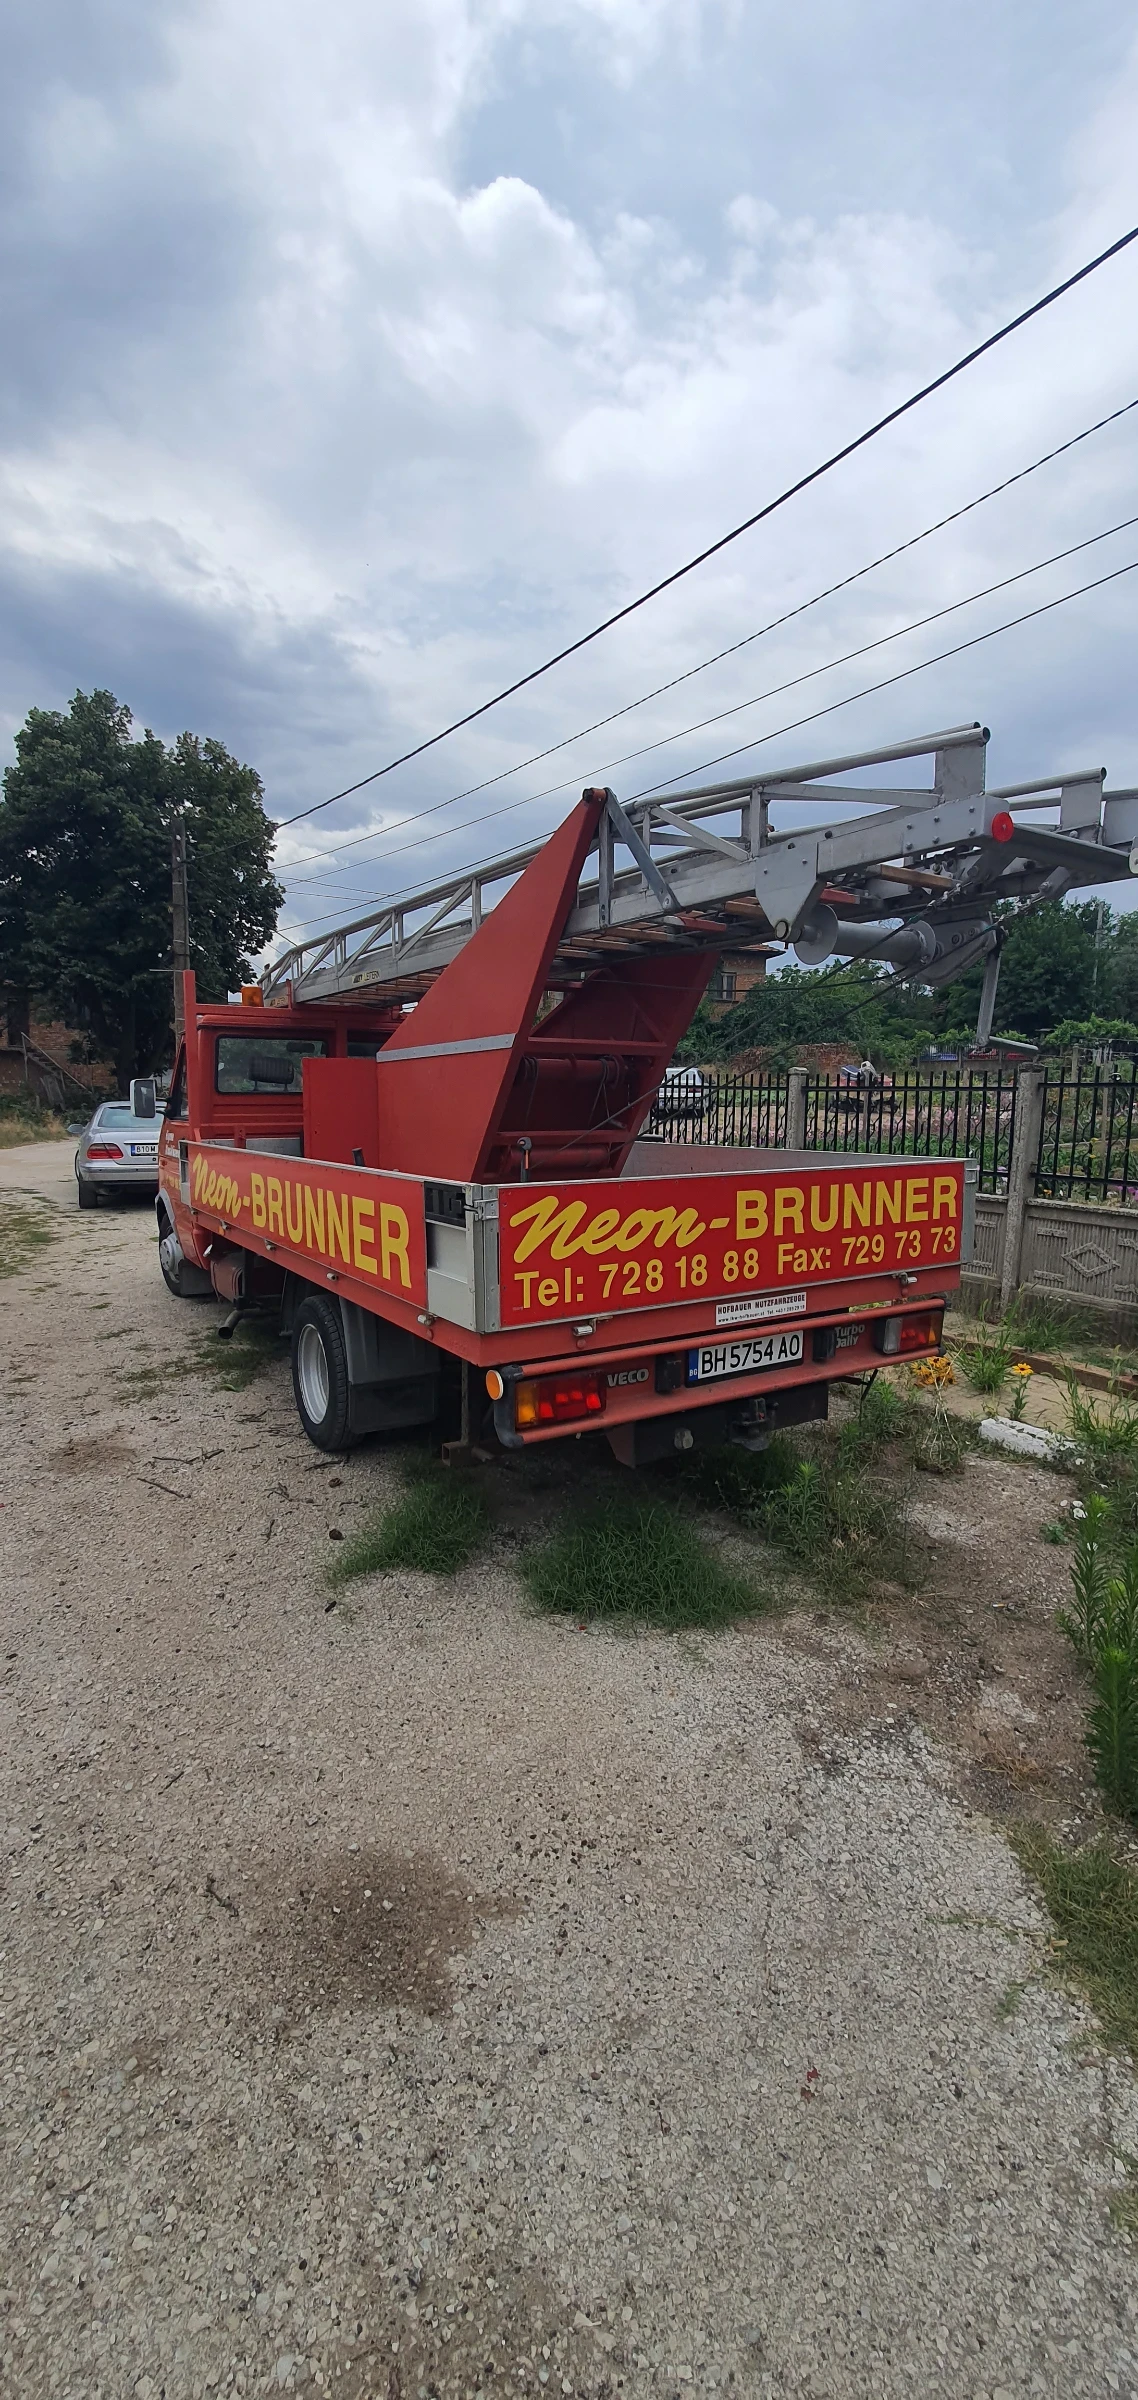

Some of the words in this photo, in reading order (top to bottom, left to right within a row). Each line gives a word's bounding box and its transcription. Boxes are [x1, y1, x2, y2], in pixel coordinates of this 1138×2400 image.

[192, 1152, 412, 1289] Neon-BRUNNER
[509, 1176, 958, 1264] Neon-BRUNNER
[514, 1270, 584, 1309] Tel:
[598, 1258, 664, 1299] 728
[674, 1253, 708, 1289] 18
[722, 1248, 760, 1283] 88
[777, 1242, 832, 1275] Fax:
[841, 1234, 885, 1267] 729
[894, 1229, 922, 1259] 73
[930, 1225, 957, 1254] 73
[717, 1303, 752, 1314] HOFBAUER
[755, 1294, 805, 1309] NUTZFAHRZEUGE
[834, 1324, 865, 1338] Turbo
[701, 1347, 727, 1375] BH
[730, 1340, 774, 1369] 5754
[777, 1334, 800, 1360] AO
[607, 1368, 650, 1387] VECO
[689, 1368, 698, 1377] BG
